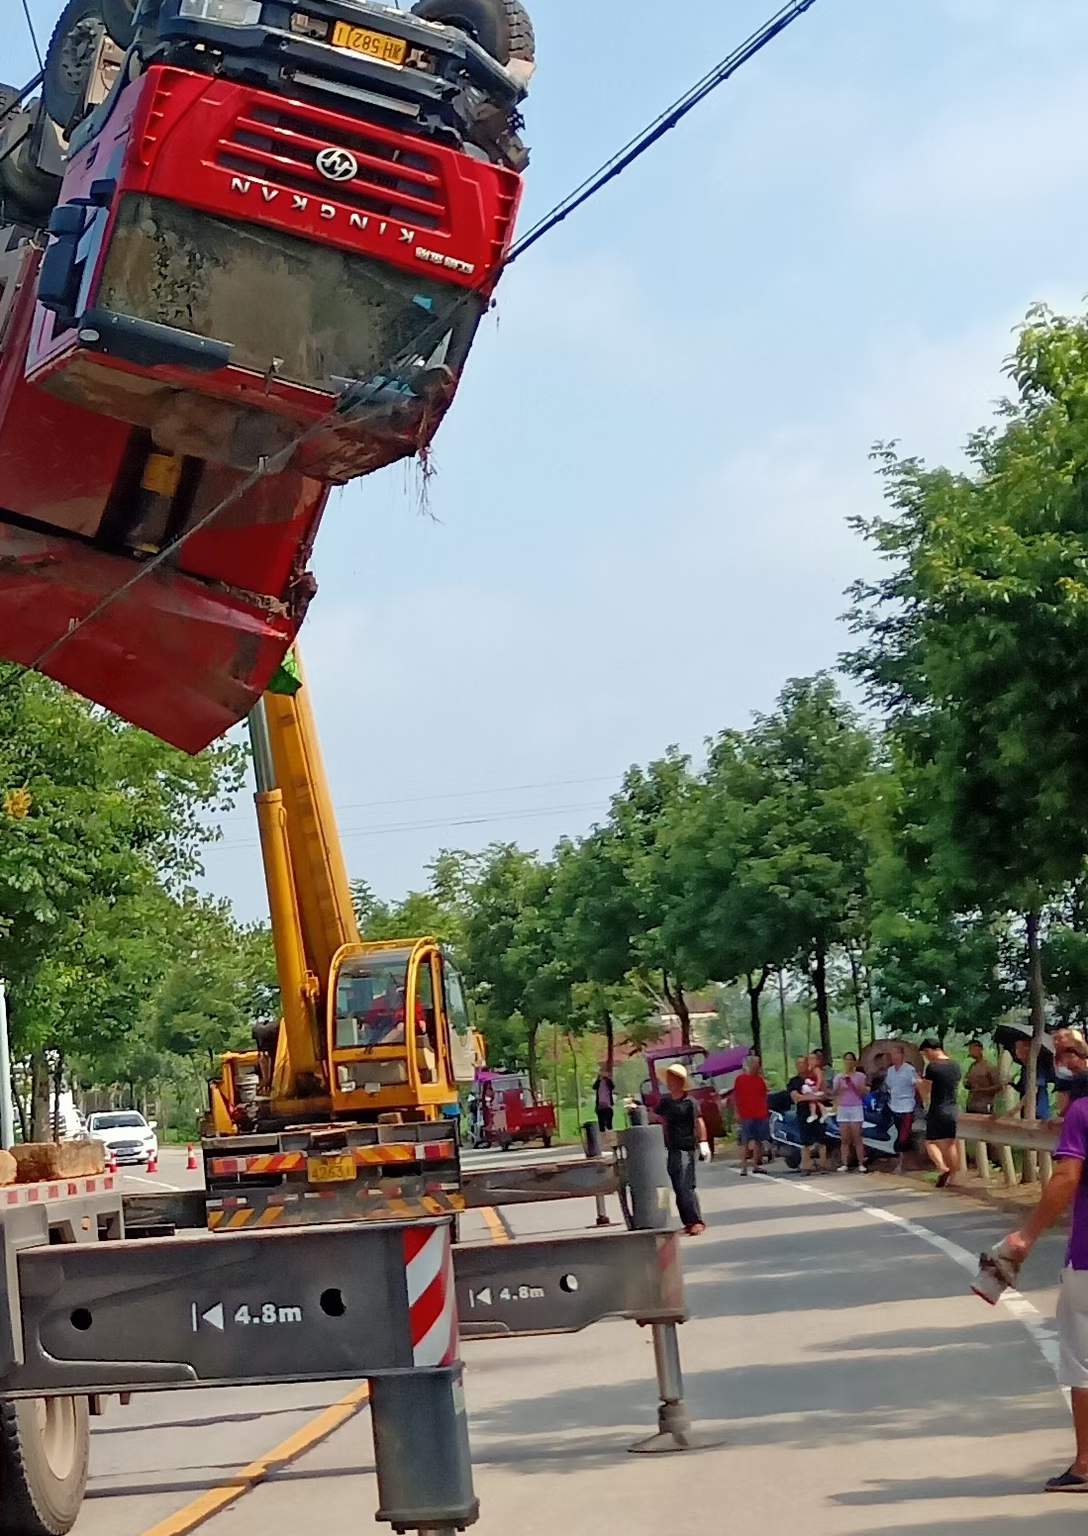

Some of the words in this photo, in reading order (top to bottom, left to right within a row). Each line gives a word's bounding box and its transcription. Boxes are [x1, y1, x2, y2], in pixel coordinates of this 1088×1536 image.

[231, 177, 415, 243] KINGKAN
[499, 1286, 546, 1302] 4.8m
[234, 1302, 303, 1325] 4.8m
